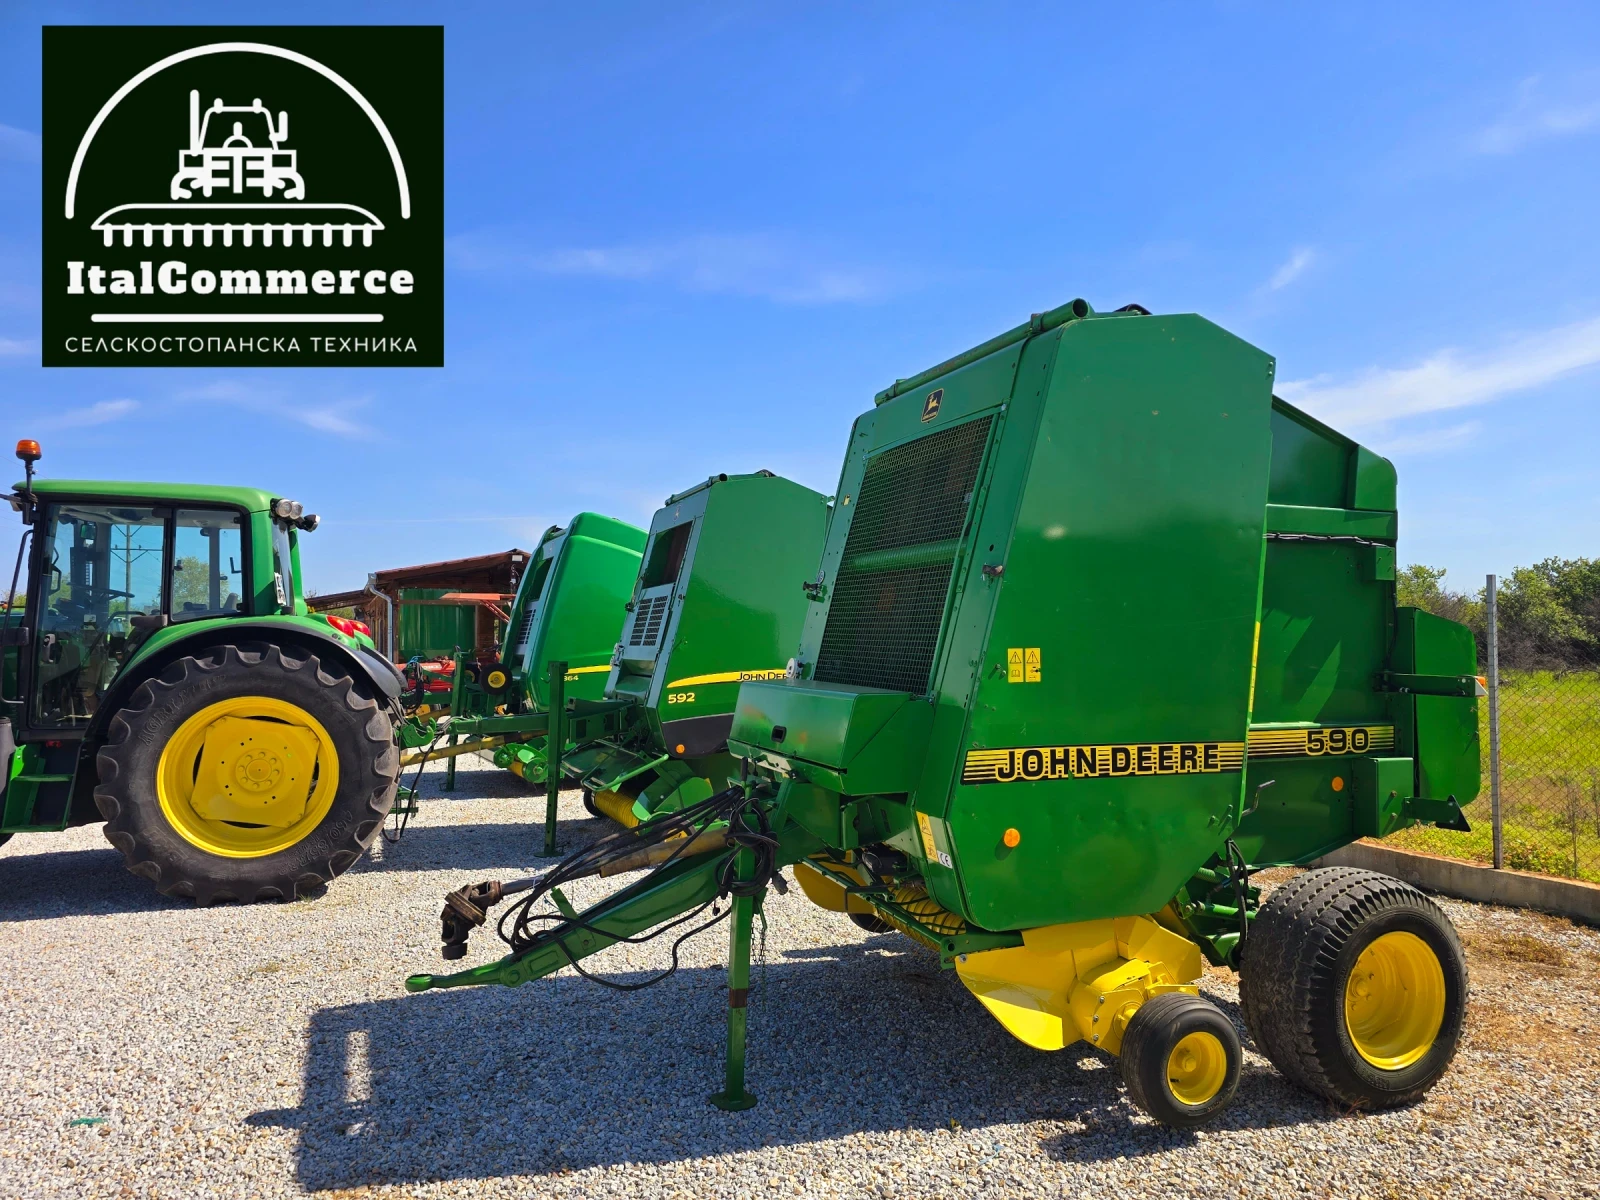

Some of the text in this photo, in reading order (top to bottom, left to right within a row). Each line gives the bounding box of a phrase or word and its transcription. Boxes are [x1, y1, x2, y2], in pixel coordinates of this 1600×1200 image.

[667, 692, 695, 704] 592
[1305, 727, 1370, 756] 590
[995, 743, 1222, 781] JOHN DEERE
